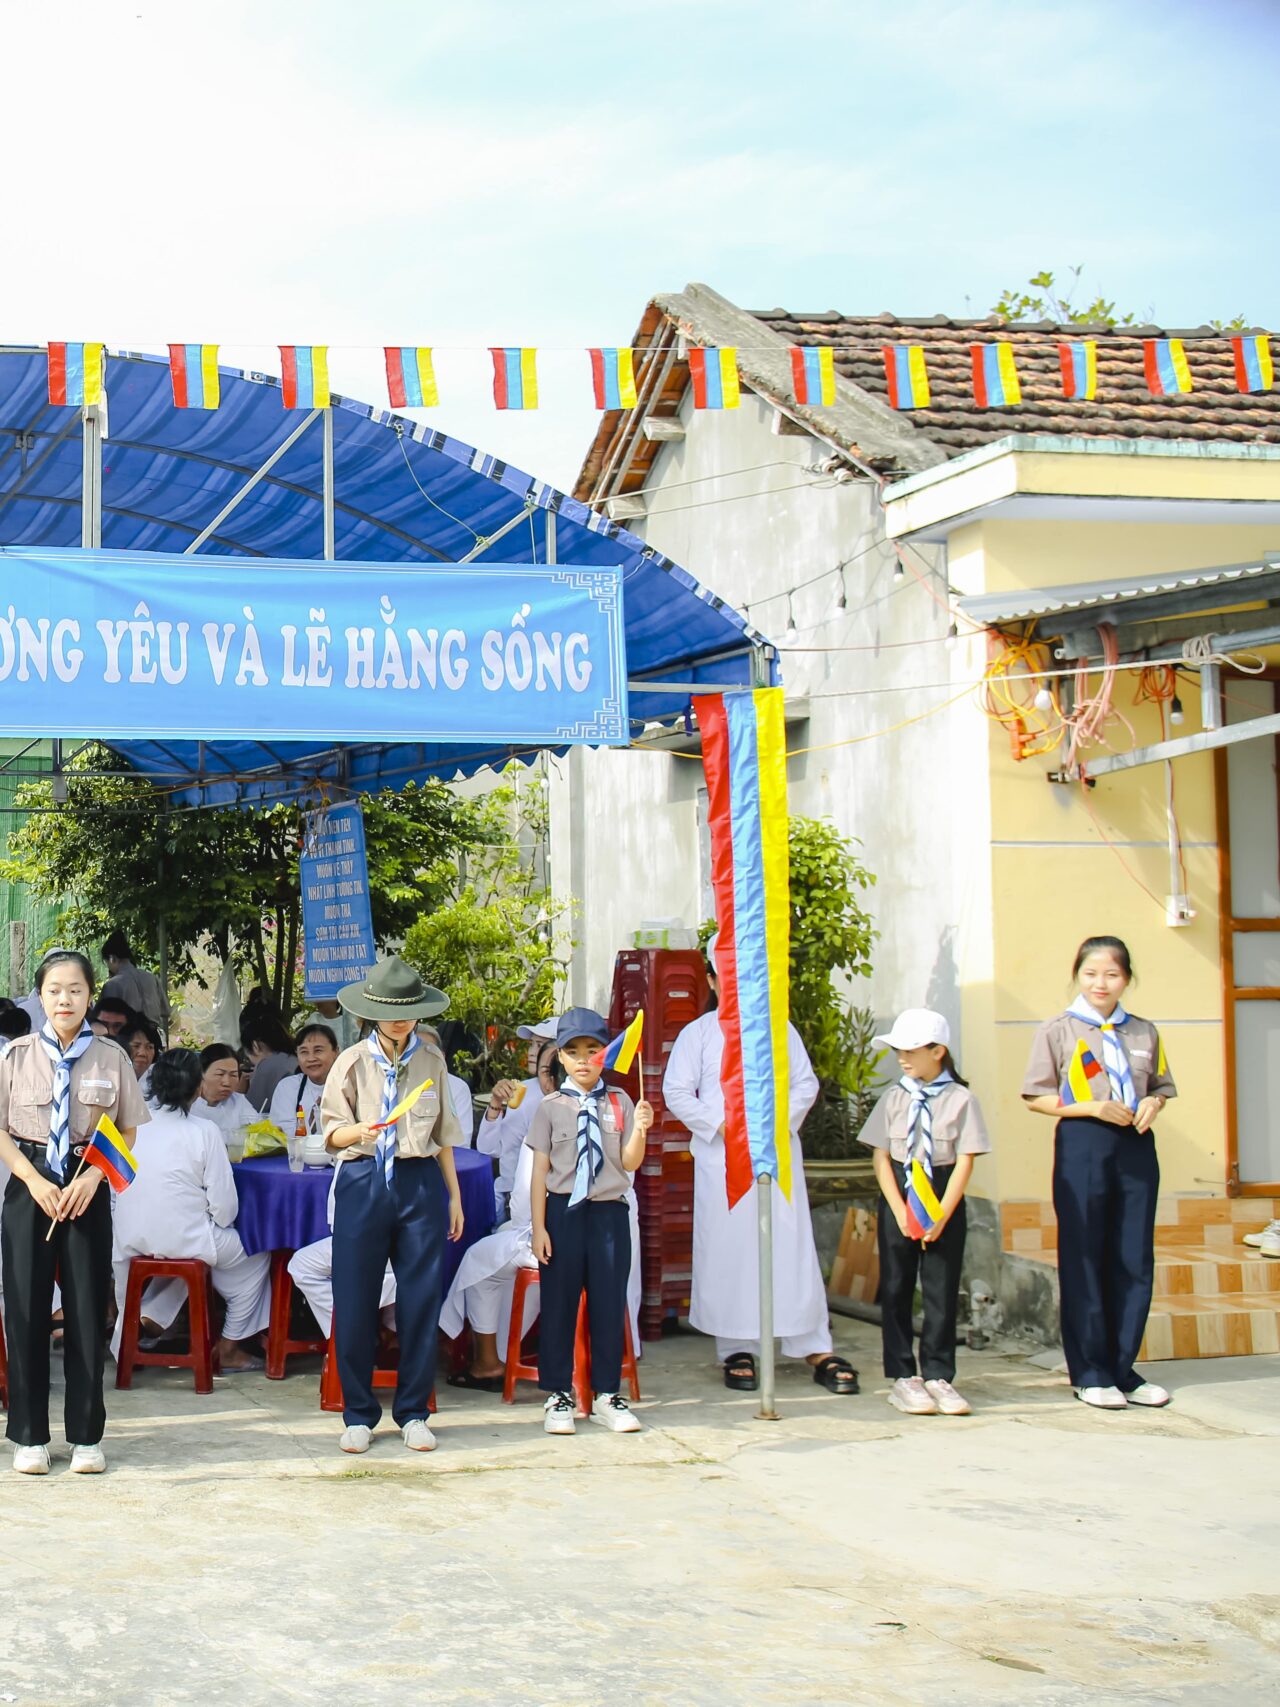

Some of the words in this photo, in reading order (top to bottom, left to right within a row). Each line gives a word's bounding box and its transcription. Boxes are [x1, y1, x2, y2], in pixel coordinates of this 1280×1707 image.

[96, 601, 189, 685] YÊU
[201, 605, 270, 686] VÀ
[281, 608, 333, 687] LẼ
[344, 594, 469, 691] HẰNG
[481, 603, 593, 693] SỐNG
